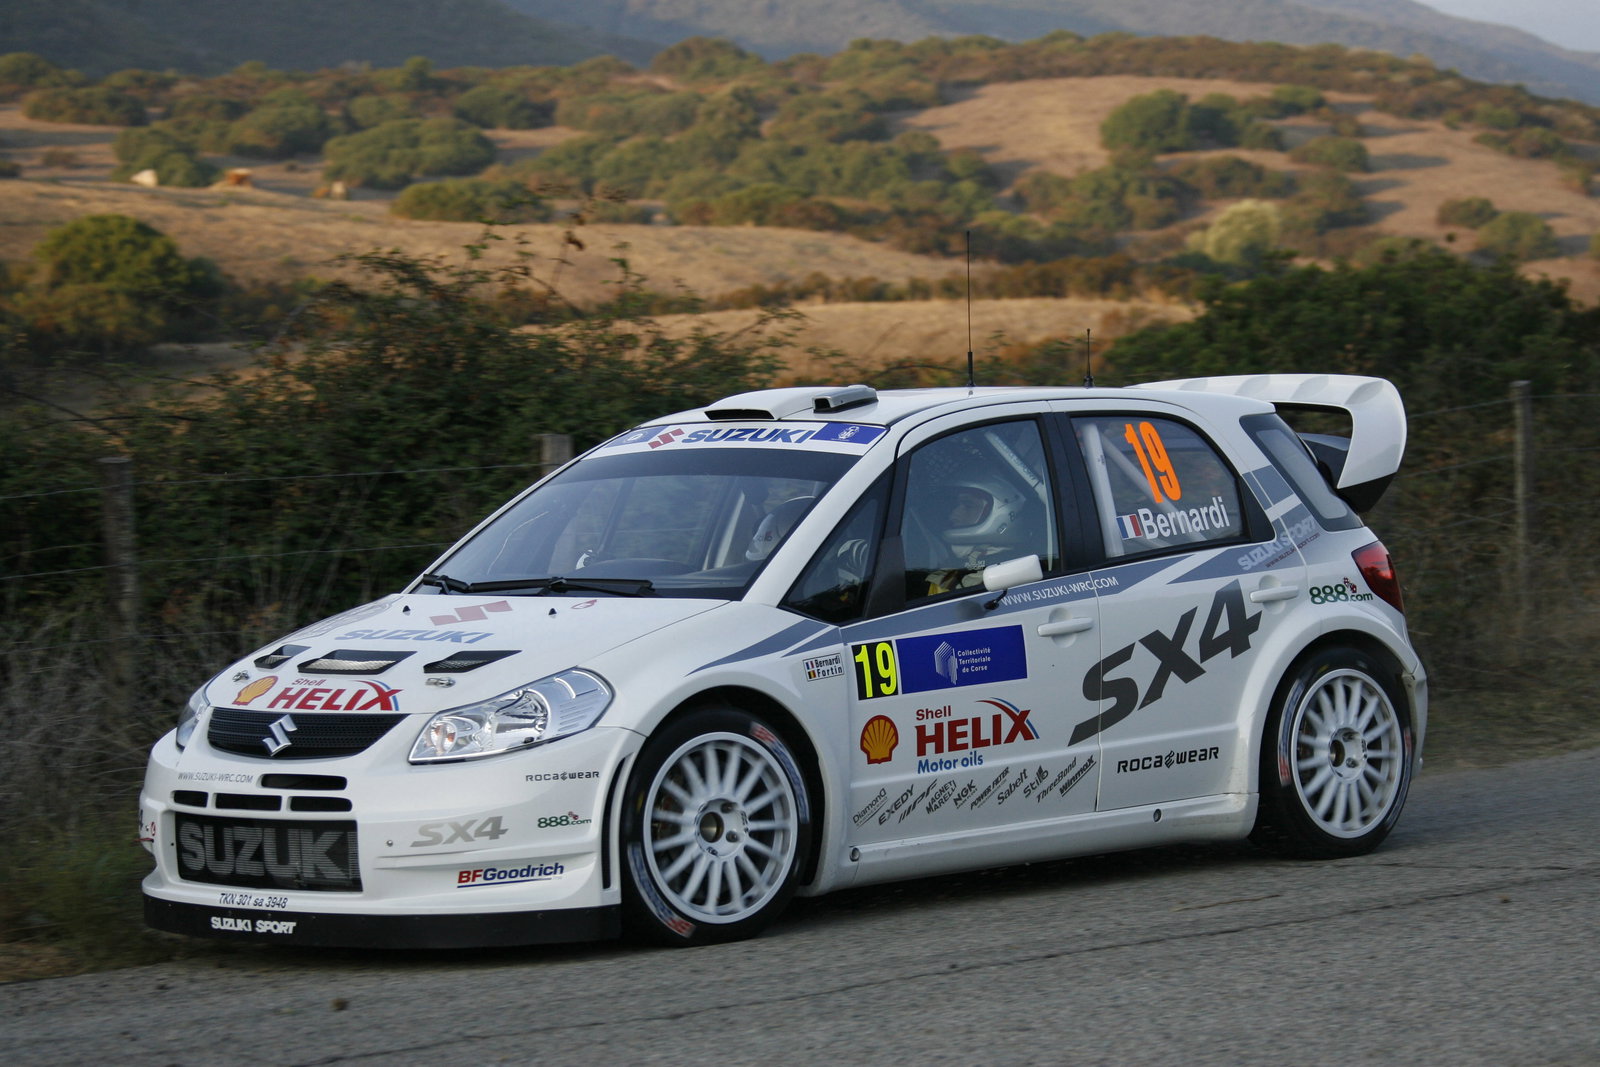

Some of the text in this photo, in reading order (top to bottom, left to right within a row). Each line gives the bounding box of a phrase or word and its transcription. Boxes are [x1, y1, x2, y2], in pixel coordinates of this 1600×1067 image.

[682, 428, 815, 444] SUZUKI
[1125, 421, 1182, 503] 19
[1137, 496, 1230, 540] Bernardi
[1237, 539, 1284, 571] SUZUKI
[1001, 576, 1119, 606] WWW.SUZUKI-WRC.COM
[1309, 582, 1373, 605] 888.com
[335, 629, 495, 644] SUZUKI
[814, 657, 841, 668] Bernardi
[957, 647, 991, 657] Collectivité
[958, 656, 991, 665] Territoriale
[1067, 578, 1262, 747] SX4
[816, 665, 843, 677] Fortin
[854, 642, 898, 698] 19
[970, 664, 988, 673] Corse
[292, 678, 326, 686] Shell
[267, 681, 403, 711] HELIX
[916, 705, 951, 721] Shell
[915, 700, 1037, 757] HELIX
[917, 751, 983, 775] Motor oils
[1058, 754, 1095, 795] Winmax
[177, 772, 254, 785] WWW.SUZUKI-WRC.COM
[997, 768, 1028, 805] Sabelt
[1023, 765, 1049, 799] Stilo
[1036, 757, 1077, 803] ThreeBond
[852, 788, 887, 824] Diamond
[878, 784, 914, 826] EXEDY
[953, 780, 976, 806] NGK
[970, 784, 992, 811] POWER
[410, 815, 509, 848] SX4
[537, 814, 592, 829] 888.com
[457, 862, 564, 884] BFGoodrich
[219, 893, 289, 909] TKN 301 sa 3948
[211, 916, 297, 935] SUZUKI SPORT
